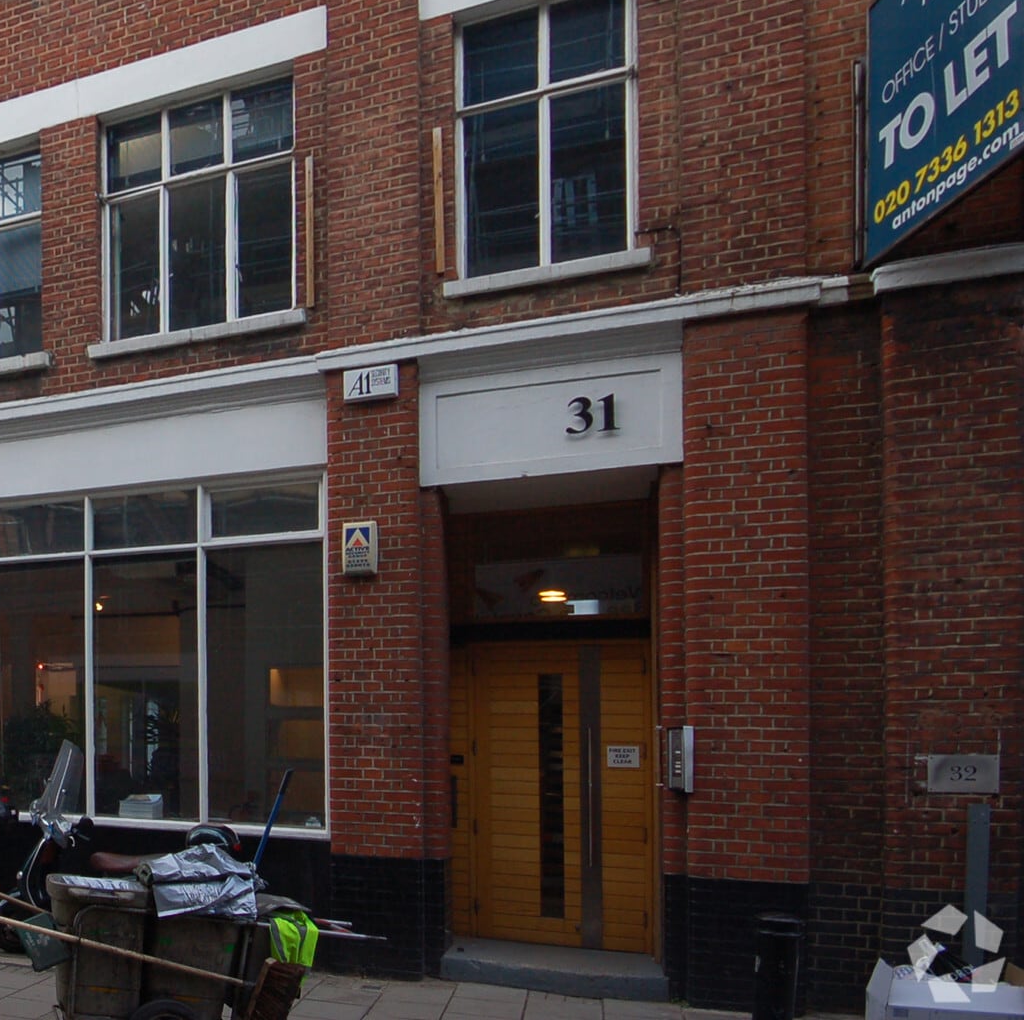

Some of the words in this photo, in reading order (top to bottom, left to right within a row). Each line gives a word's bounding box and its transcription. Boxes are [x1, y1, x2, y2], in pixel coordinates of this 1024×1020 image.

[878, 91, 936, 170] TO
[943, 0, 1018, 117] LET
[881, 35, 936, 104] OFFICE
[873, 179, 911, 224] 020
[914, 133, 969, 194] 7336
[973, 88, 1020, 146] 1313
[891, 121, 1020, 230] antonpage.com
[347, 370, 372, 397] A1
[565, 392, 621, 436] 31
[950, 765, 977, 781] 32
